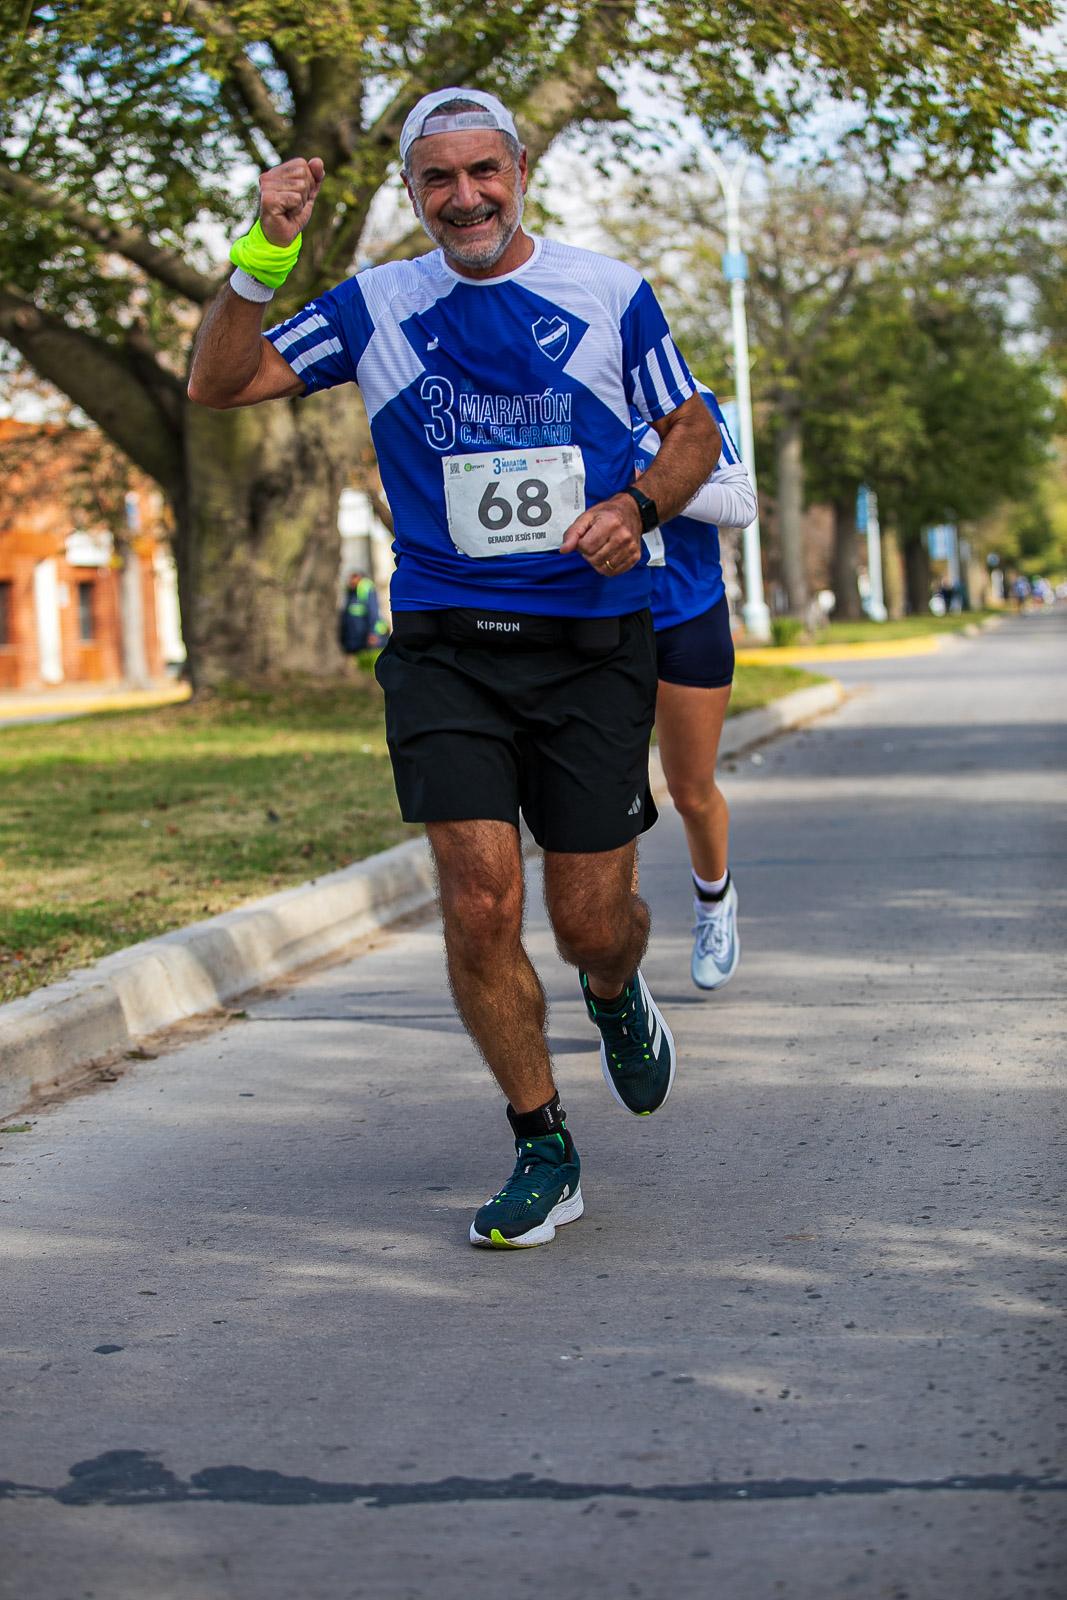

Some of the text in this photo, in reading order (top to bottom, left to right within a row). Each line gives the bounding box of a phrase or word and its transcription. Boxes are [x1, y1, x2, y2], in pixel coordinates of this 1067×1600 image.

[420, 375, 455, 451] 3
[459, 387, 572, 424] MARATÓN
[492, 457, 502, 475] 3
[501, 459, 527, 468] MARATÓN
[477, 478, 552, 531] 68
[487, 531, 547, 545] GERARDO JESÚS FIORI
[476, 620, 520, 632] KIPRUN
